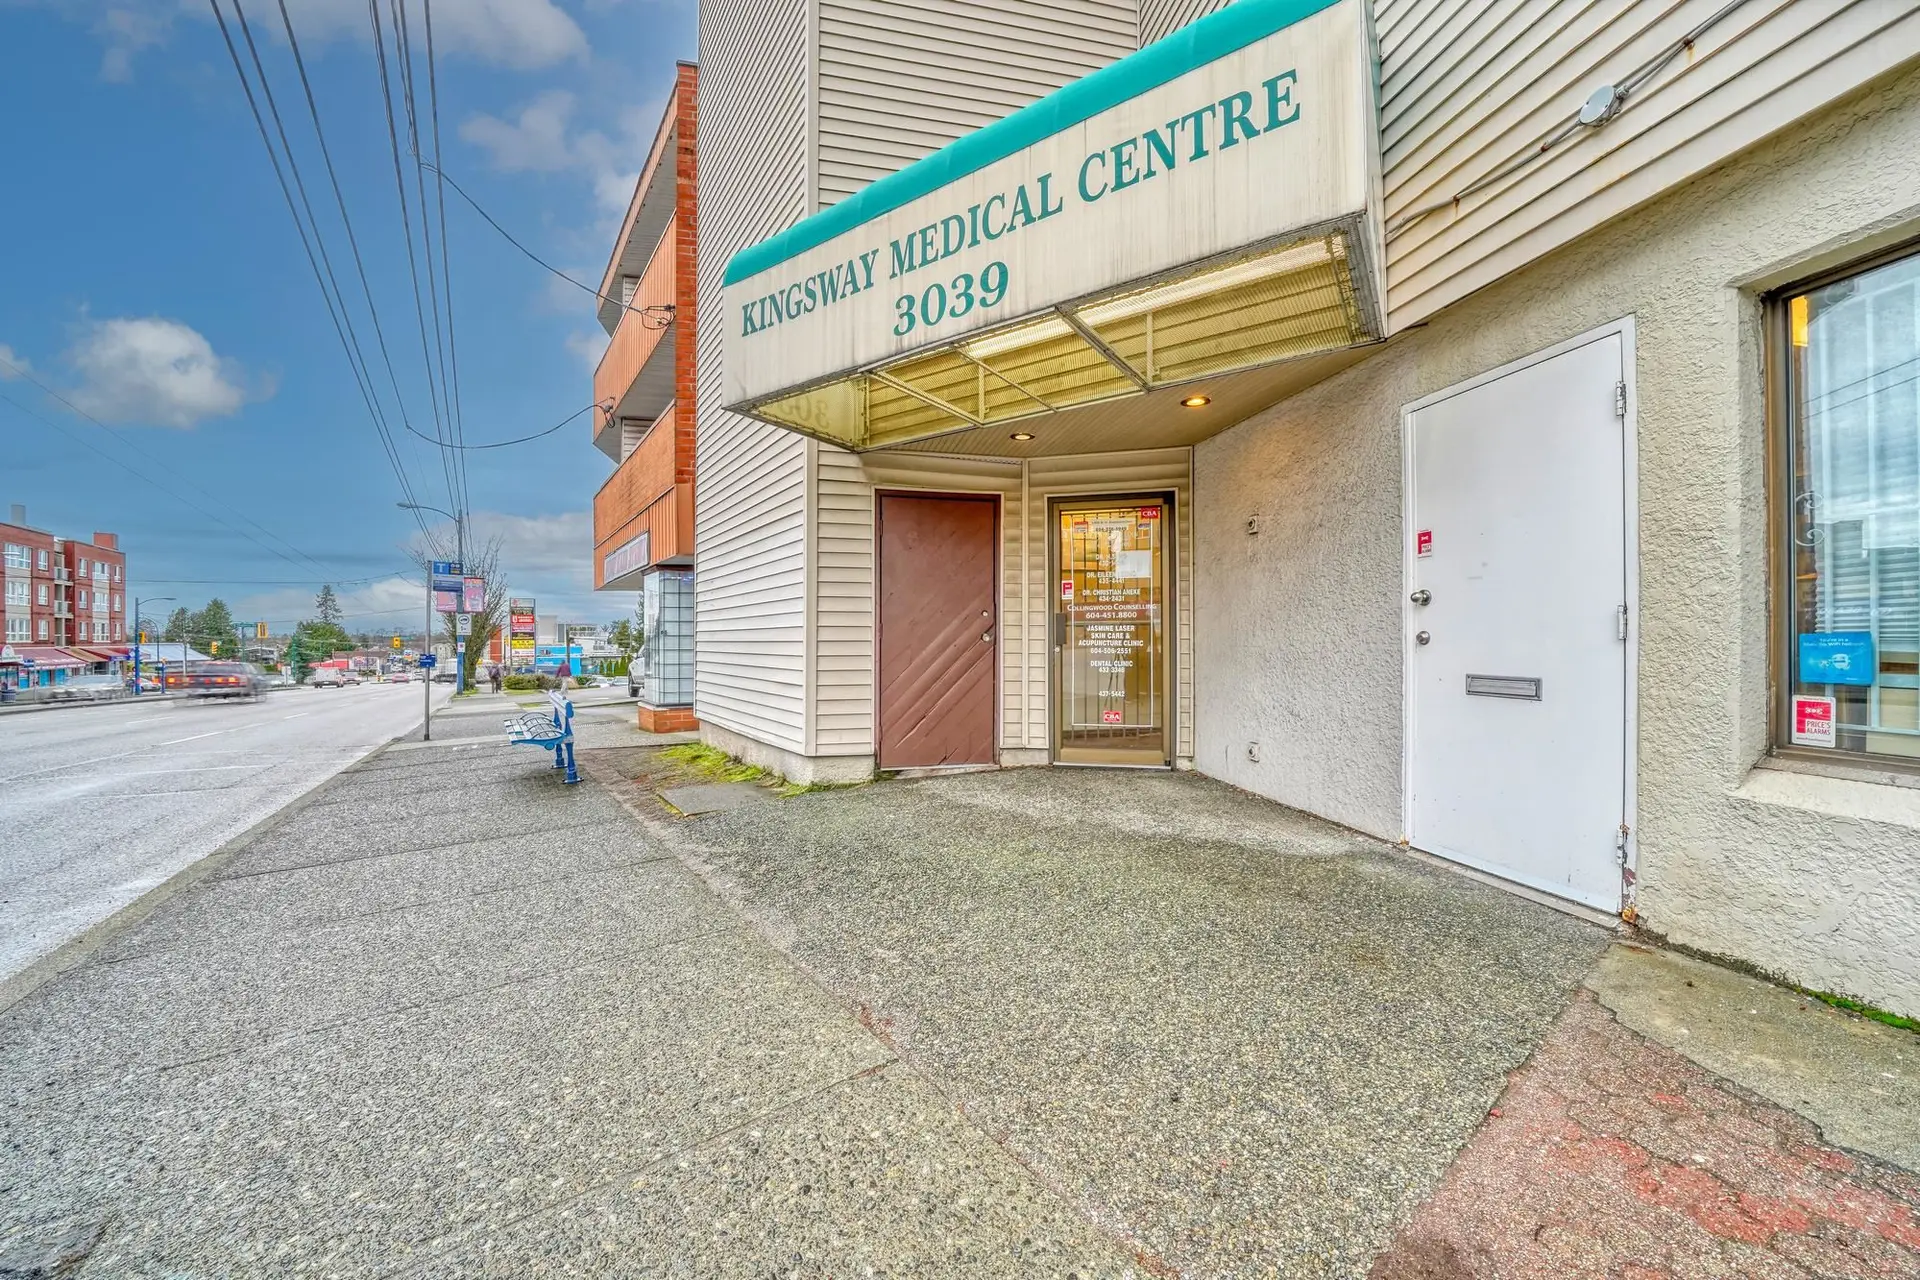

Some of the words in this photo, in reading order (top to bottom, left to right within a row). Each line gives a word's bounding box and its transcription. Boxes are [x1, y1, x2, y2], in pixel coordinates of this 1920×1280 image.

[741, 248, 880, 338] KINGSWAY
[889, 173, 1065, 281] MEDICAL
[1078, 68, 1302, 203] CENTRE
[893, 261, 1010, 338] 3039
[1806, 720, 1831, 729] PRICE'S
